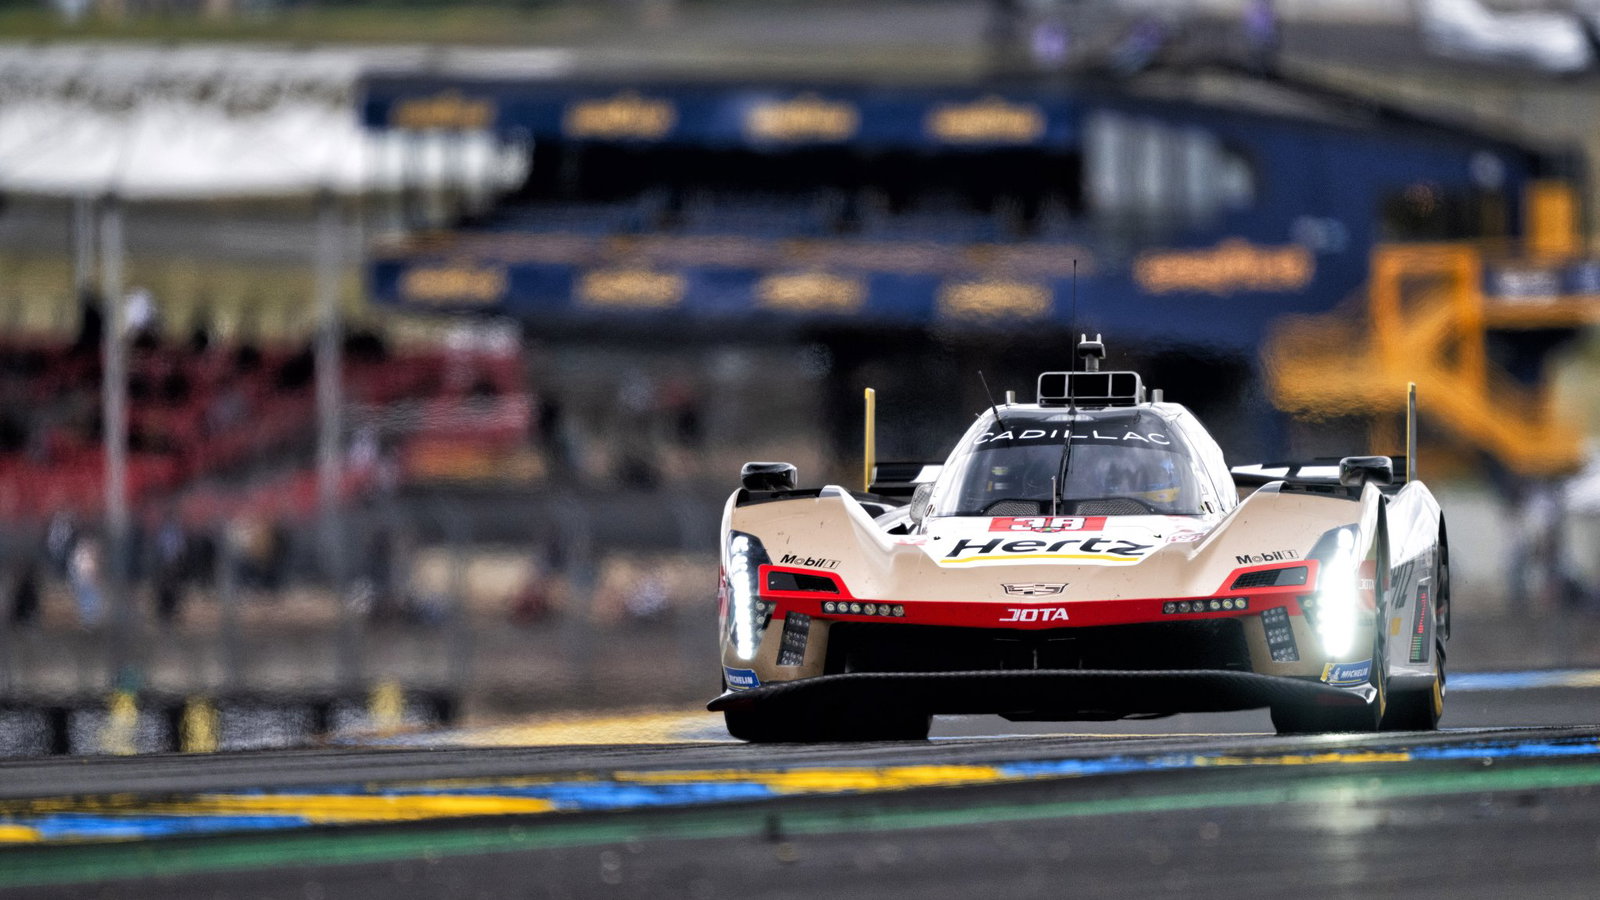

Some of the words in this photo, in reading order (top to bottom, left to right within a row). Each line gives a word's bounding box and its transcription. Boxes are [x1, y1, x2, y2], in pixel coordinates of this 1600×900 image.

[973, 429, 1170, 445] CADILLAC
[945, 537, 1154, 557] Hertz
[780, 554, 826, 567] Mobil
[1235, 551, 1283, 564] Mobil
[999, 607, 1069, 622] JOTA
